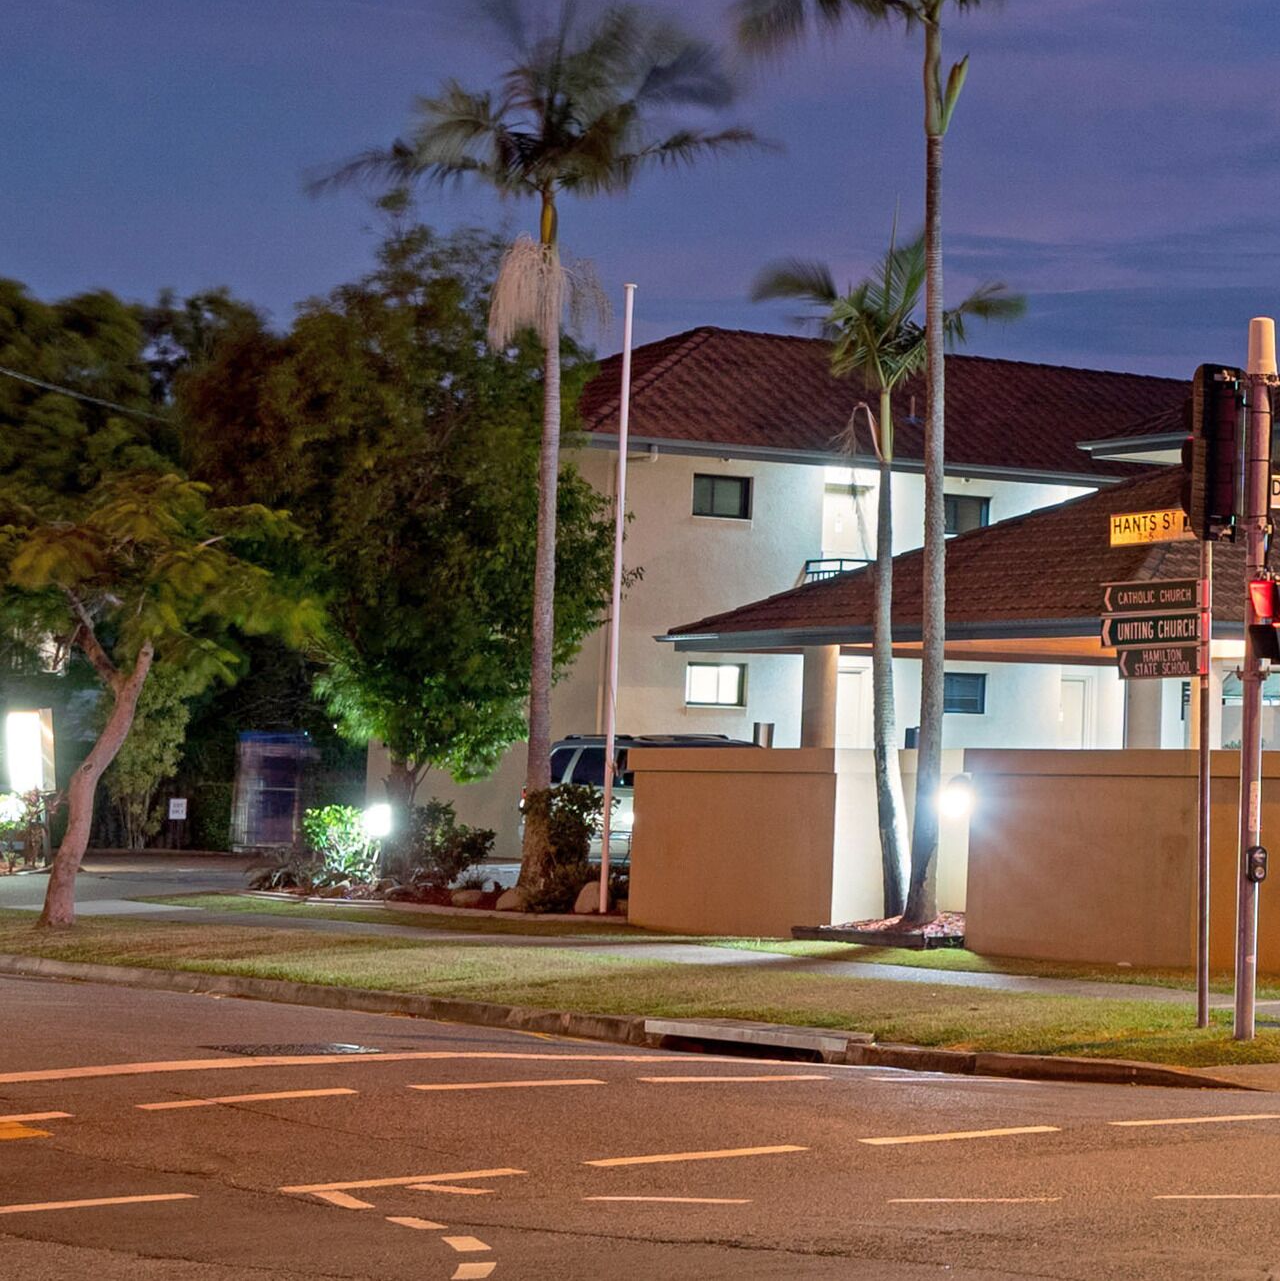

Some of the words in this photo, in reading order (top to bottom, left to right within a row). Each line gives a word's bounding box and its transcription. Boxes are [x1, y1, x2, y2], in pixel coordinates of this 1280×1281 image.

[1113, 515, 1157, 534] HANTS
[1162, 513, 1177, 530] ST
[1117, 590, 1155, 605] CATHOLIC
[1160, 588, 1192, 603] CHURCH
[1117, 621, 1155, 641] UNITING
[1157, 618, 1196, 639] CHURCH
[1142, 649, 1182, 663] HAMILTON
[1134, 663, 1158, 676] STATE
[1162, 661, 1191, 675] SCHOOL
